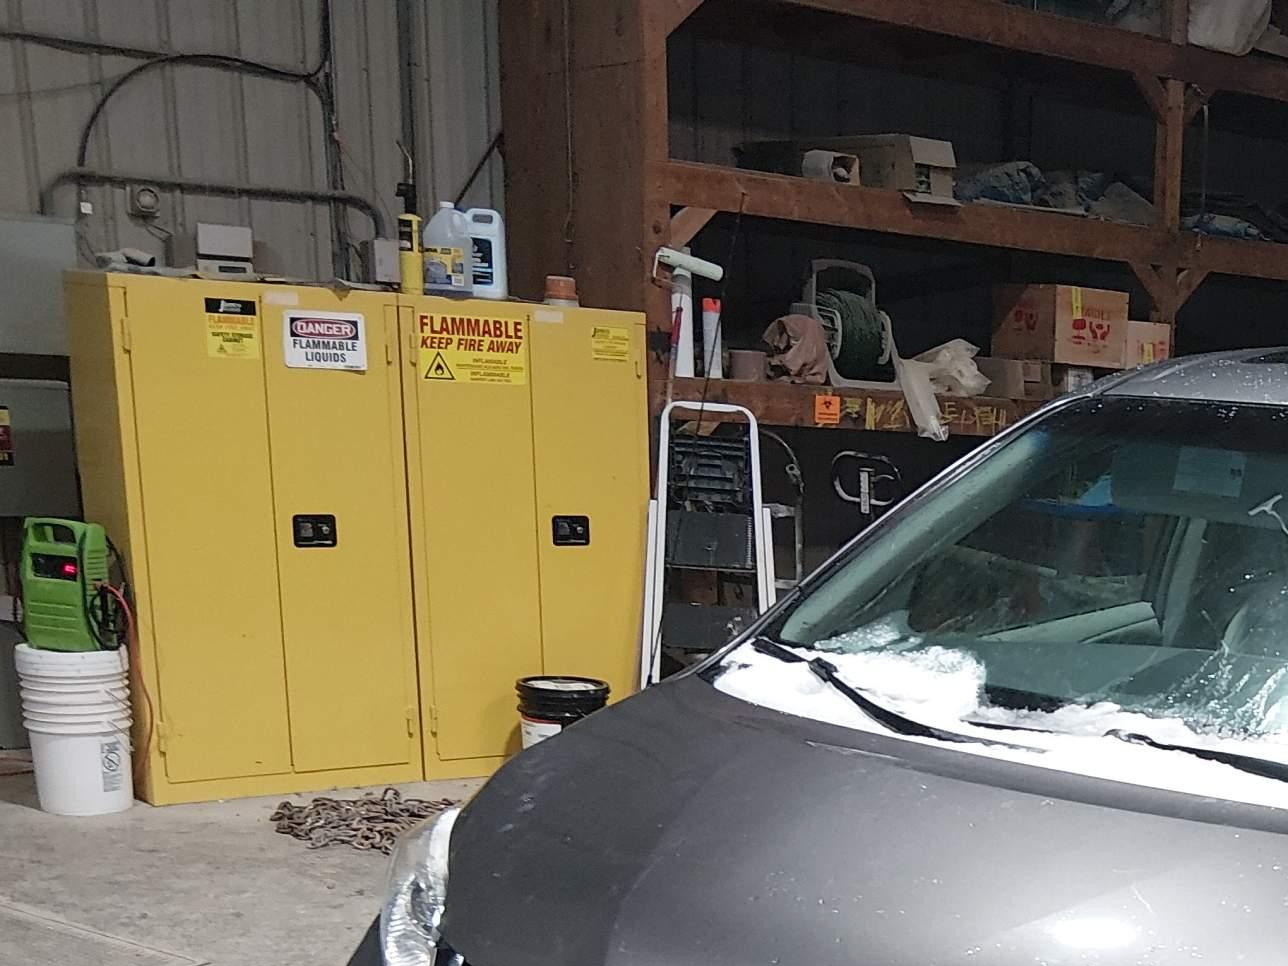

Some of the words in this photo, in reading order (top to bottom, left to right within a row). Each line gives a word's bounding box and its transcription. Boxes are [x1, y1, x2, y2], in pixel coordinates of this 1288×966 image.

[296, 321, 353, 337] DANGER
[419, 315, 524, 340] FLAMMABLE
[292, 339, 358, 352] FLAMMABLE
[420, 335, 454, 350] KEEP
[456, 338, 485, 352] FIRE
[487, 340, 522, 354] AWAY
[305, 351, 347, 363] LIQUIDS
